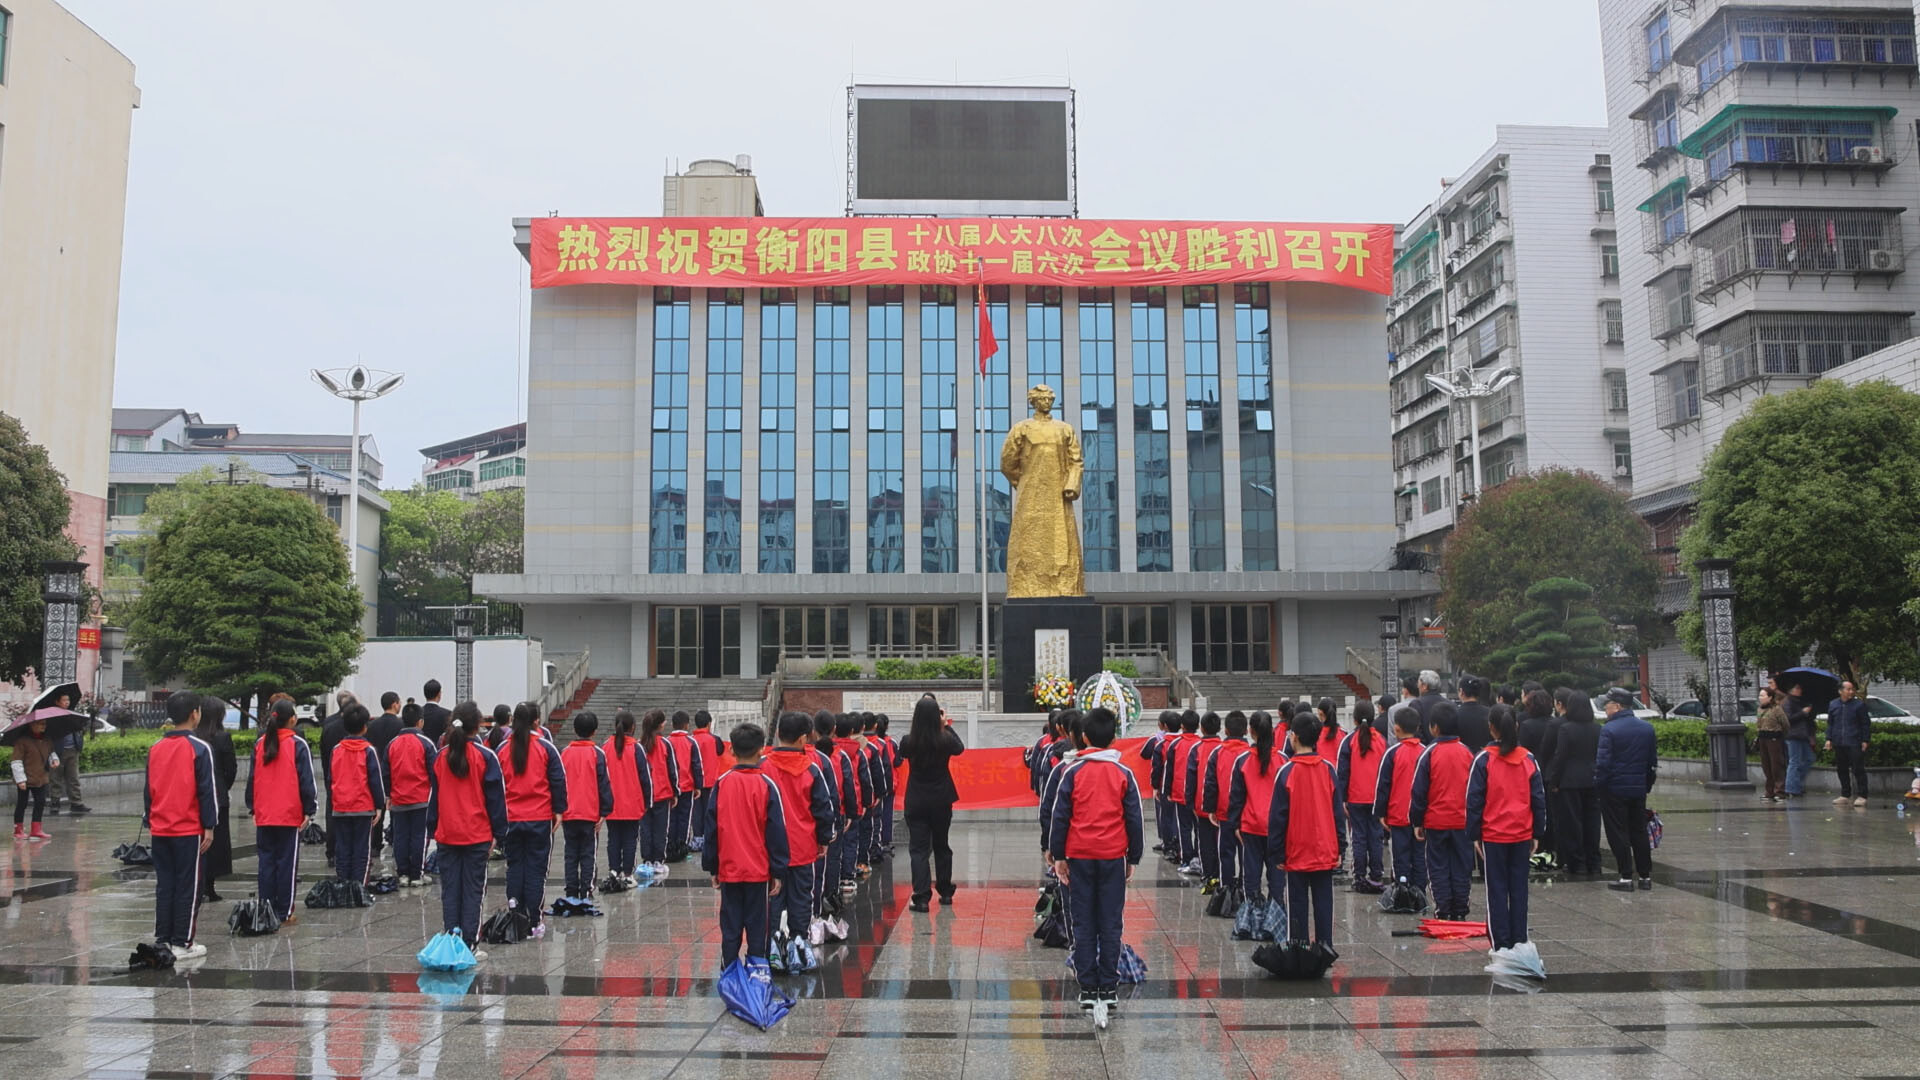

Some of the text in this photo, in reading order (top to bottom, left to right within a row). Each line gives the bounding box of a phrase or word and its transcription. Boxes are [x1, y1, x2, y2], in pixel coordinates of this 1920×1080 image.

[557, 224, 899, 275] 热烈祝贺衡阳县
[906, 223, 1083, 248] 十八届人大八次
[1089, 227, 1371, 277] 会议胜利召开
[906, 249, 1085, 276] 政协十一届六次
